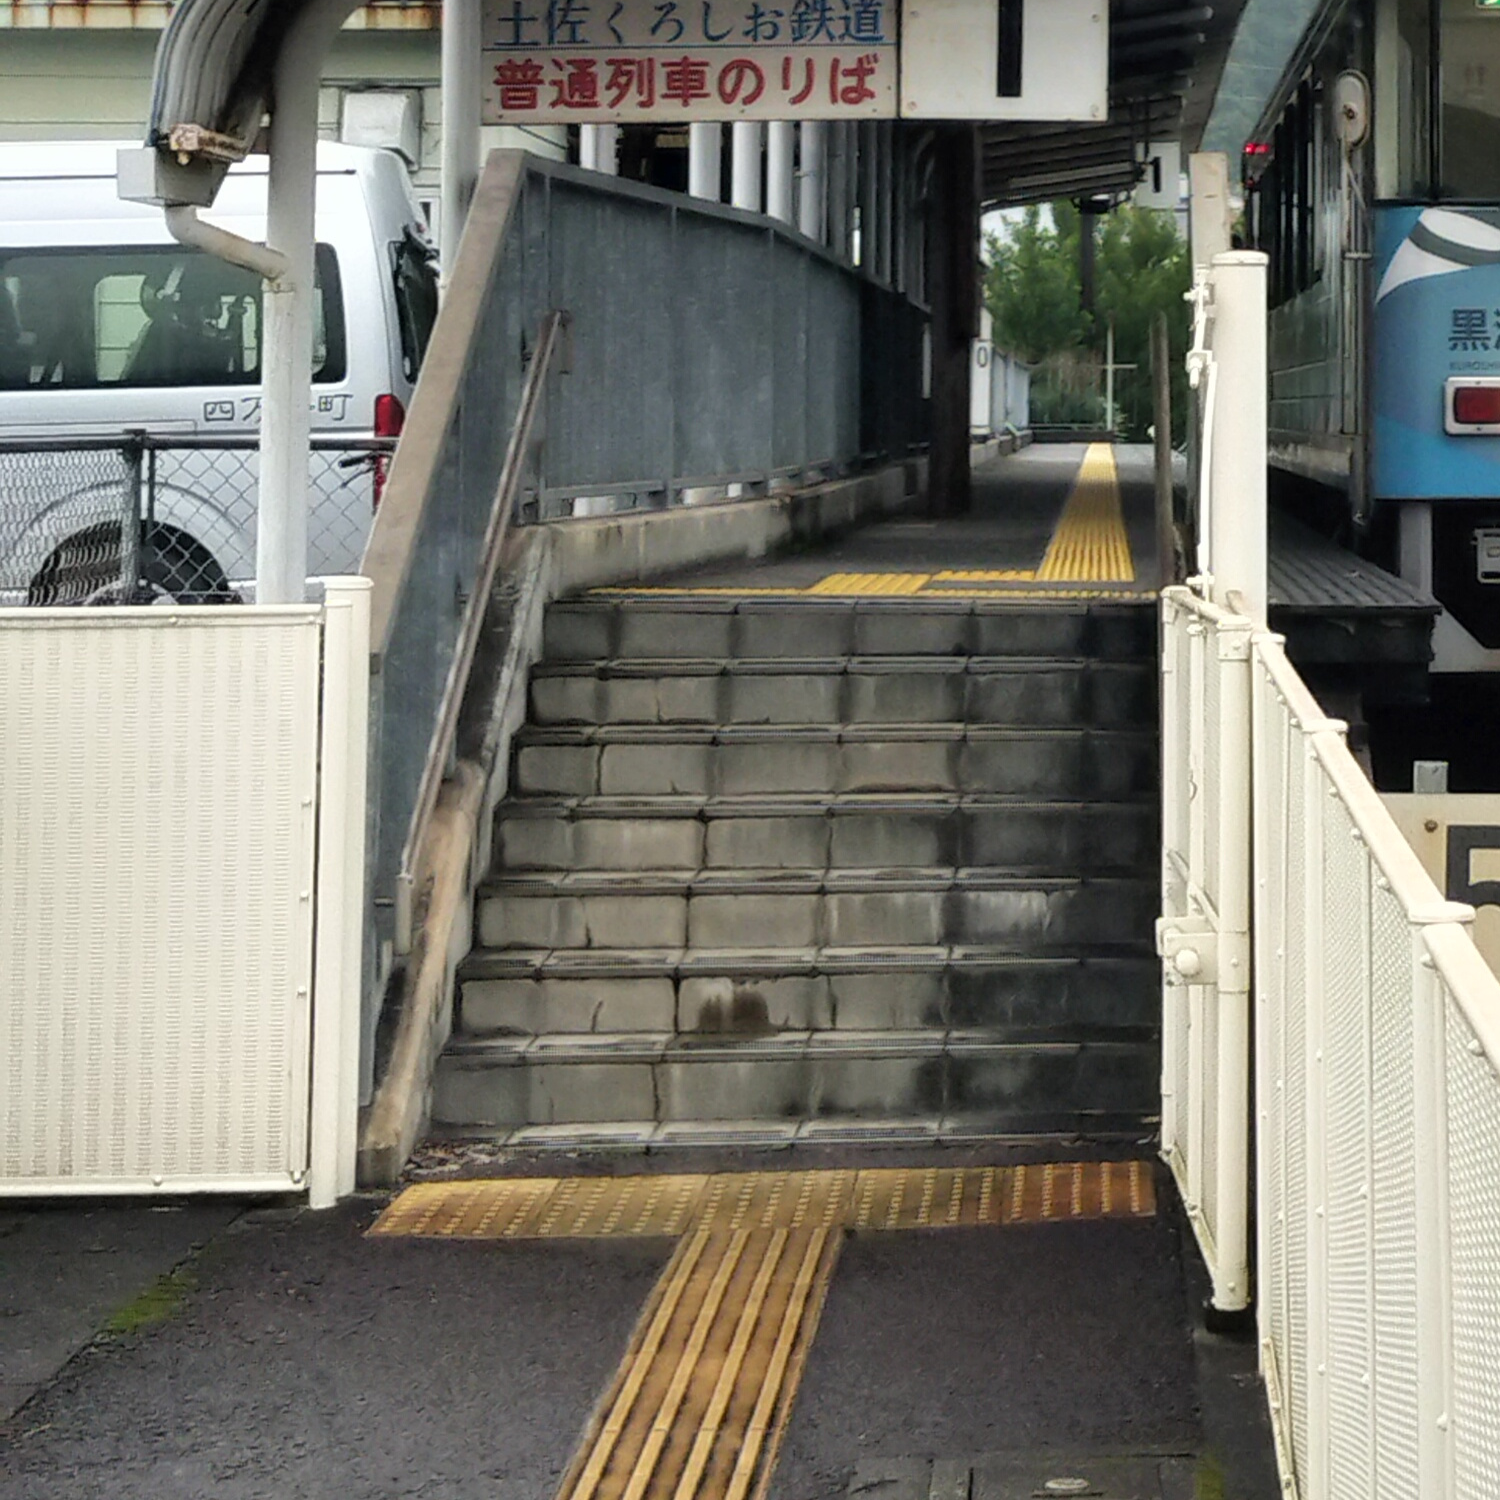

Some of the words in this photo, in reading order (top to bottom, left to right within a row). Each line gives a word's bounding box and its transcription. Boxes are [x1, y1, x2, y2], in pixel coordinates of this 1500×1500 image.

[493, 54, 879, 110] 普通列車のりば
